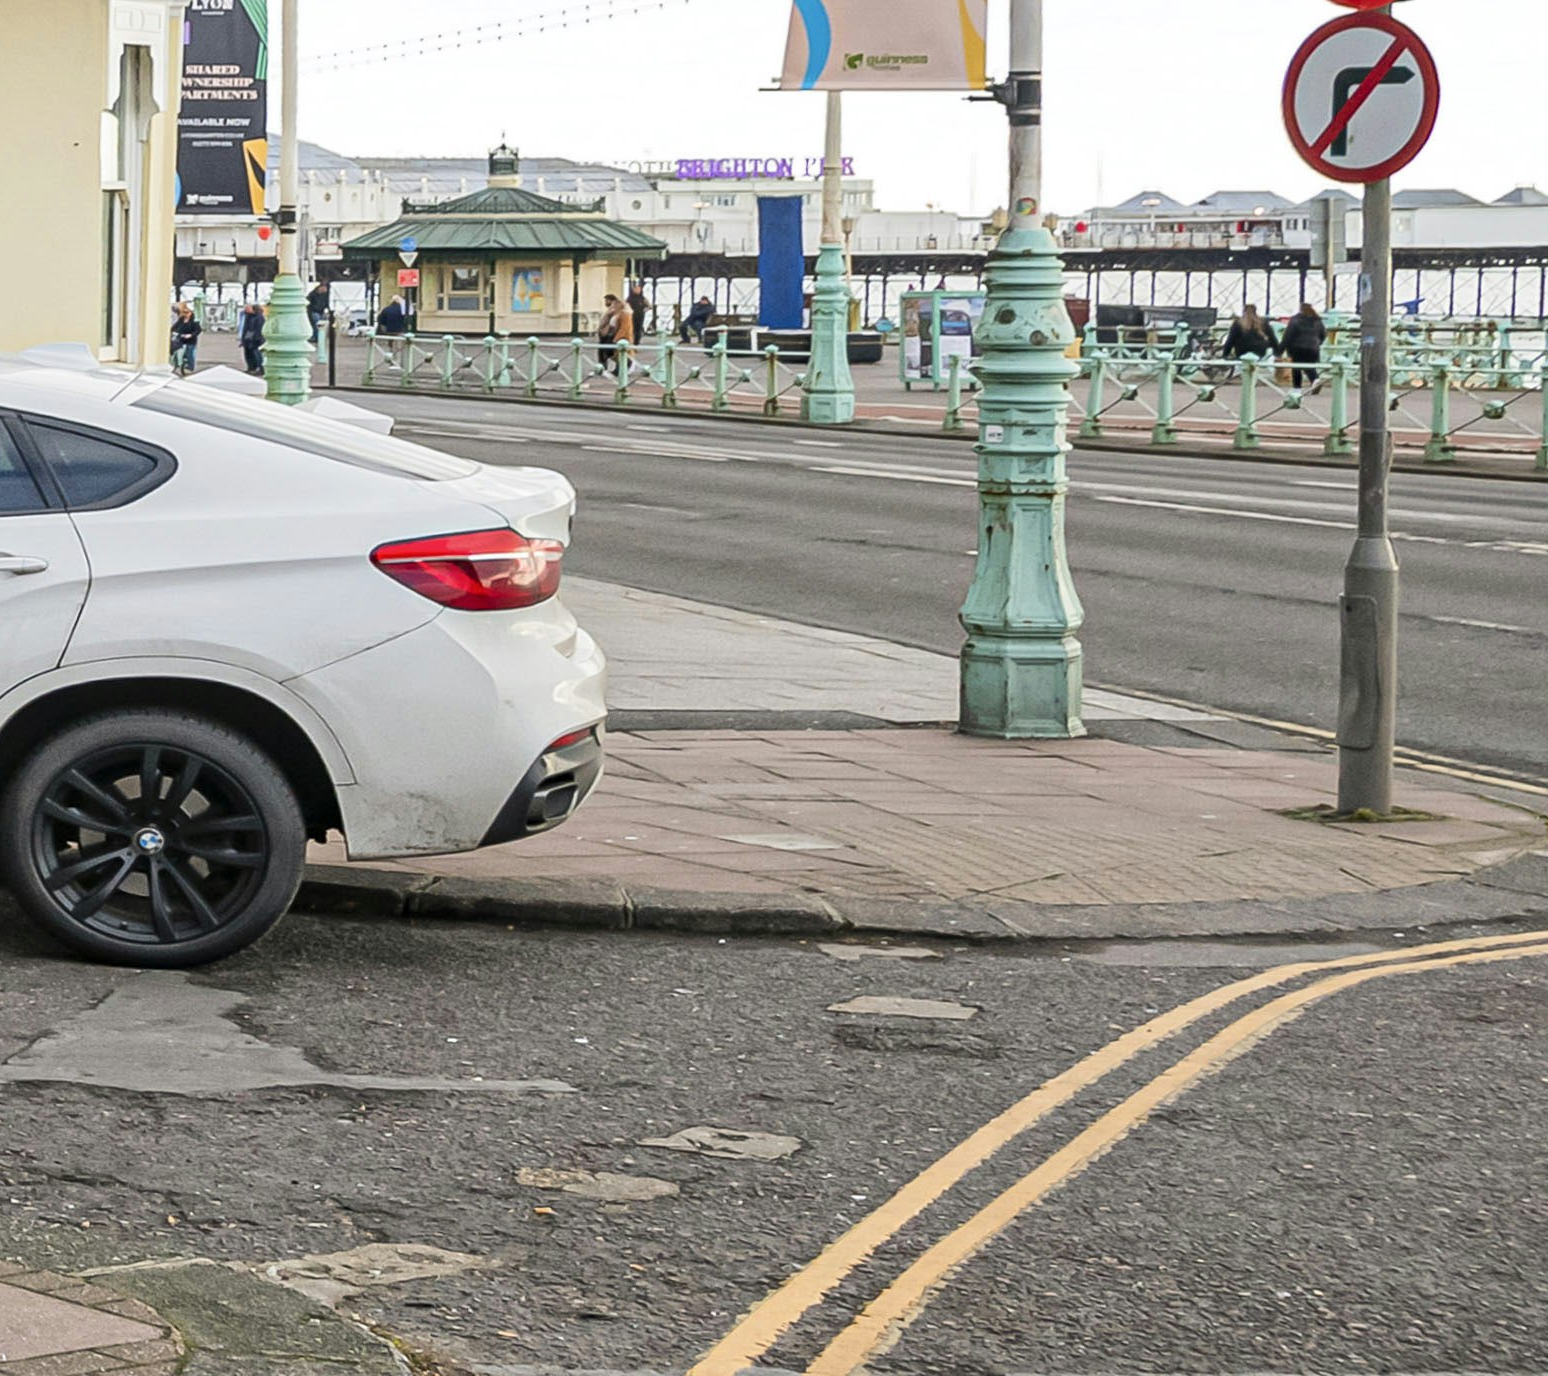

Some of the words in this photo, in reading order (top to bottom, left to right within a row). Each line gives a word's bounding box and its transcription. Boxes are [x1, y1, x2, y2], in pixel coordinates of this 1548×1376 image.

[185, 64, 241, 75] SHARED
[182, 76, 255, 87] WNERSHIP
[676, 158, 793, 178] BRIGHTON
